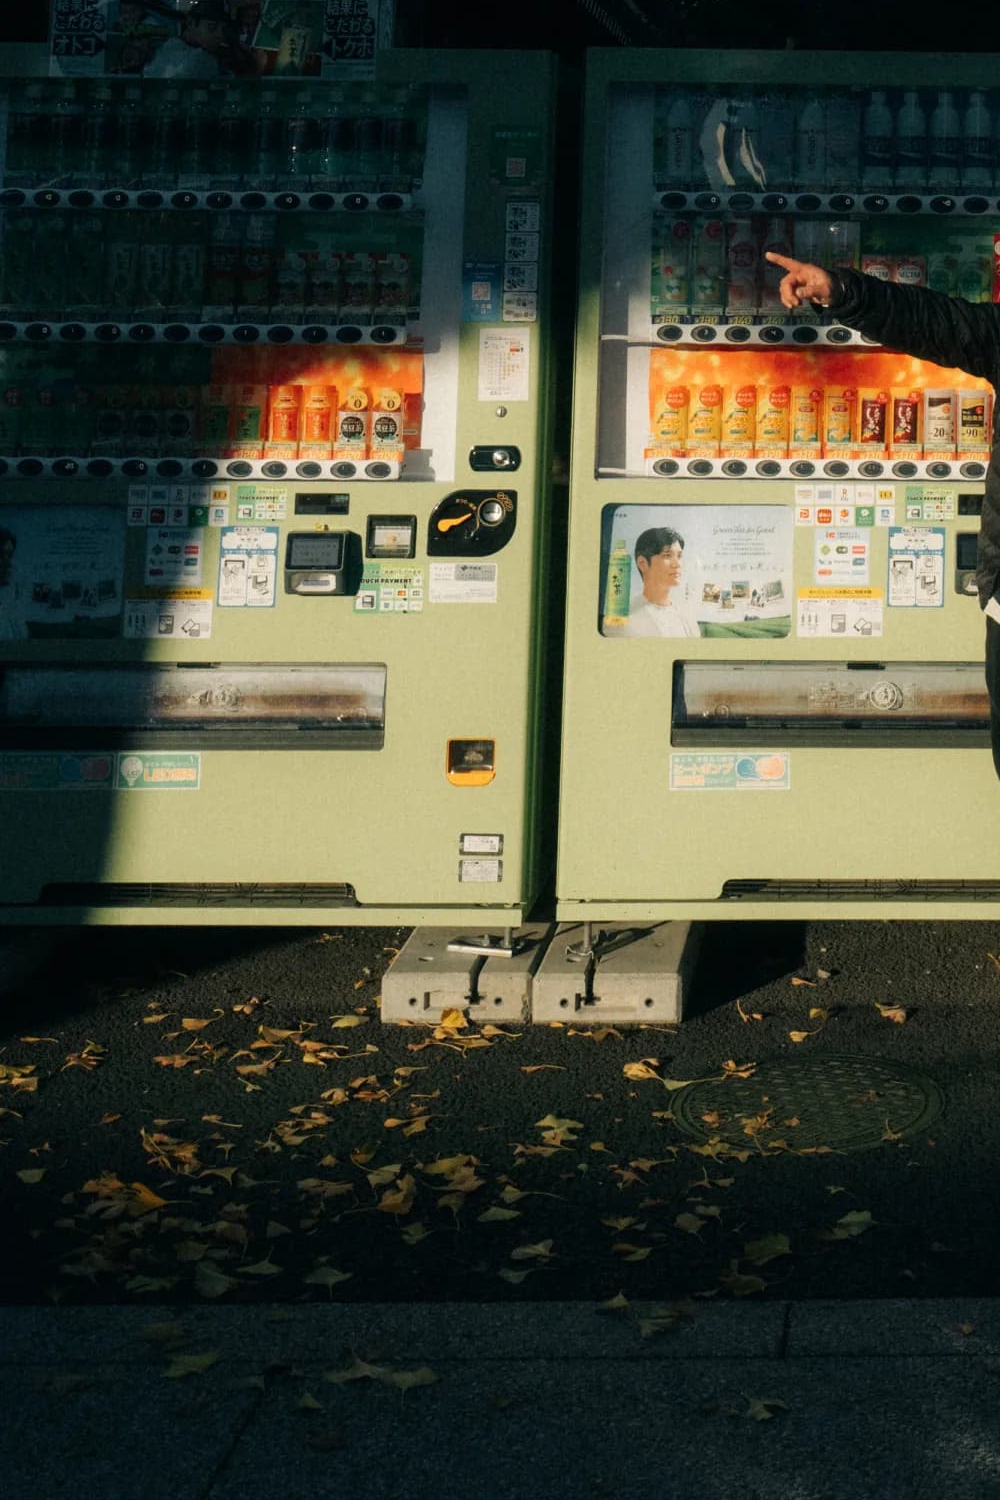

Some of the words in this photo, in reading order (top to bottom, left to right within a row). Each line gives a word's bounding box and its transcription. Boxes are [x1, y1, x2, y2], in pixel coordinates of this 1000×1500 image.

[55, 35, 97, 54] オトコ
[330, 38, 373, 58] トクホ
